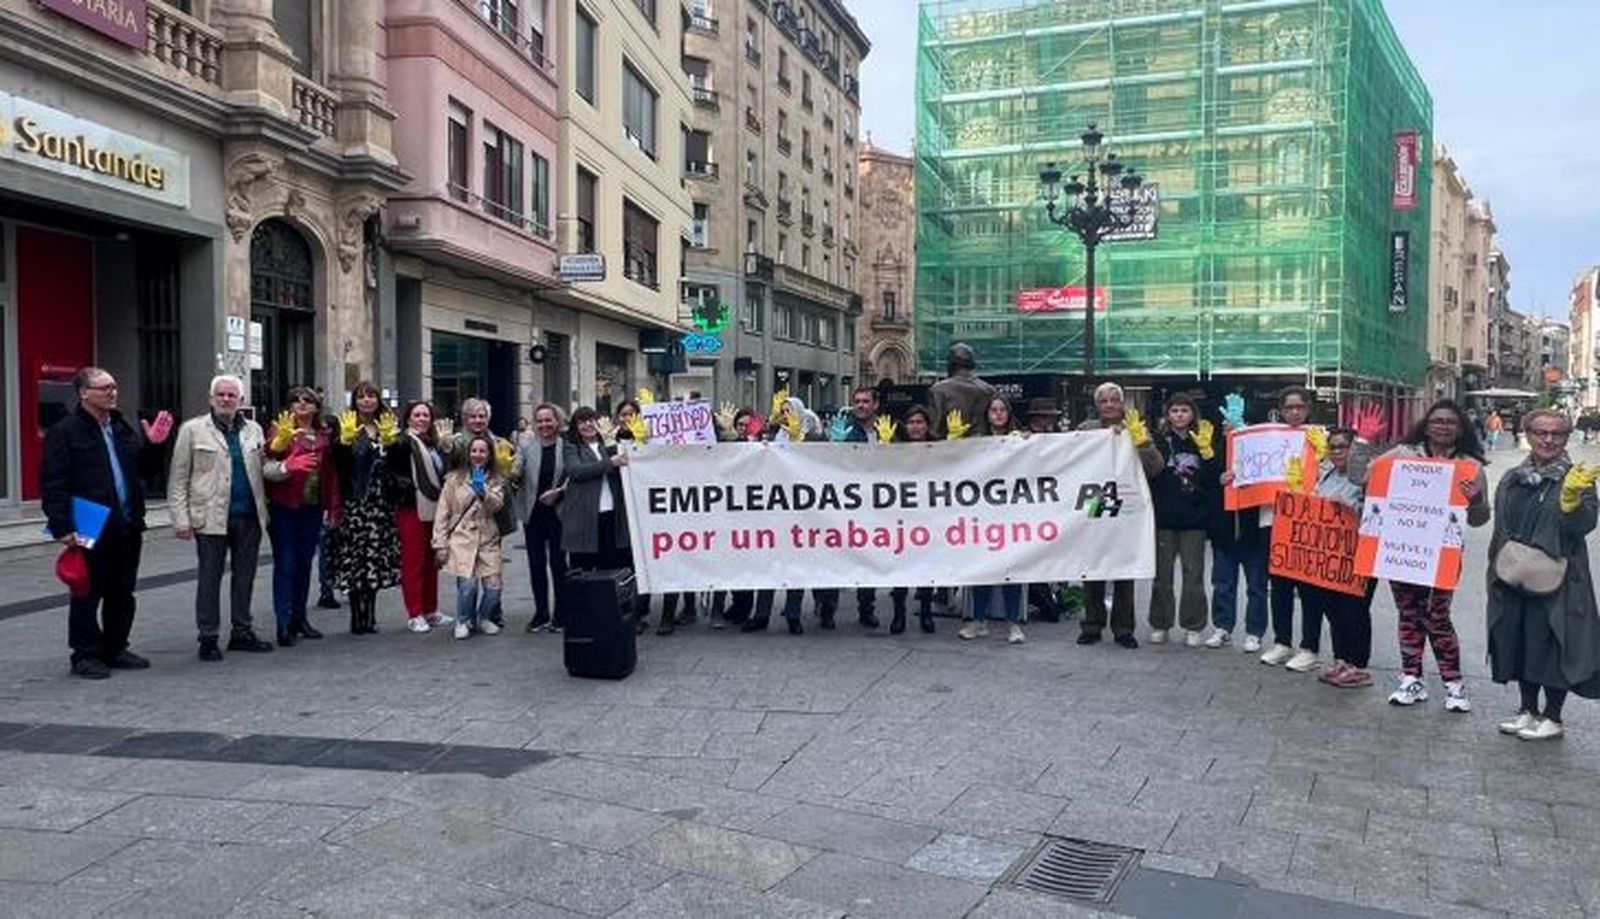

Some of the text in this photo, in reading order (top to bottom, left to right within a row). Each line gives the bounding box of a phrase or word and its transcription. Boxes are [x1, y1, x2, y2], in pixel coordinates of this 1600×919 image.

[14, 116, 170, 190] Santander
[1401, 463, 1443, 476] PORQUE
[648, 476, 1060, 514] EMPLEADAS DE HOGAR
[1273, 490, 1295, 519] NO
[1298, 496, 1313, 522] A
[652, 517, 1059, 560] por un trabajo digno
[1383, 554, 1428, 570] MUNDO
